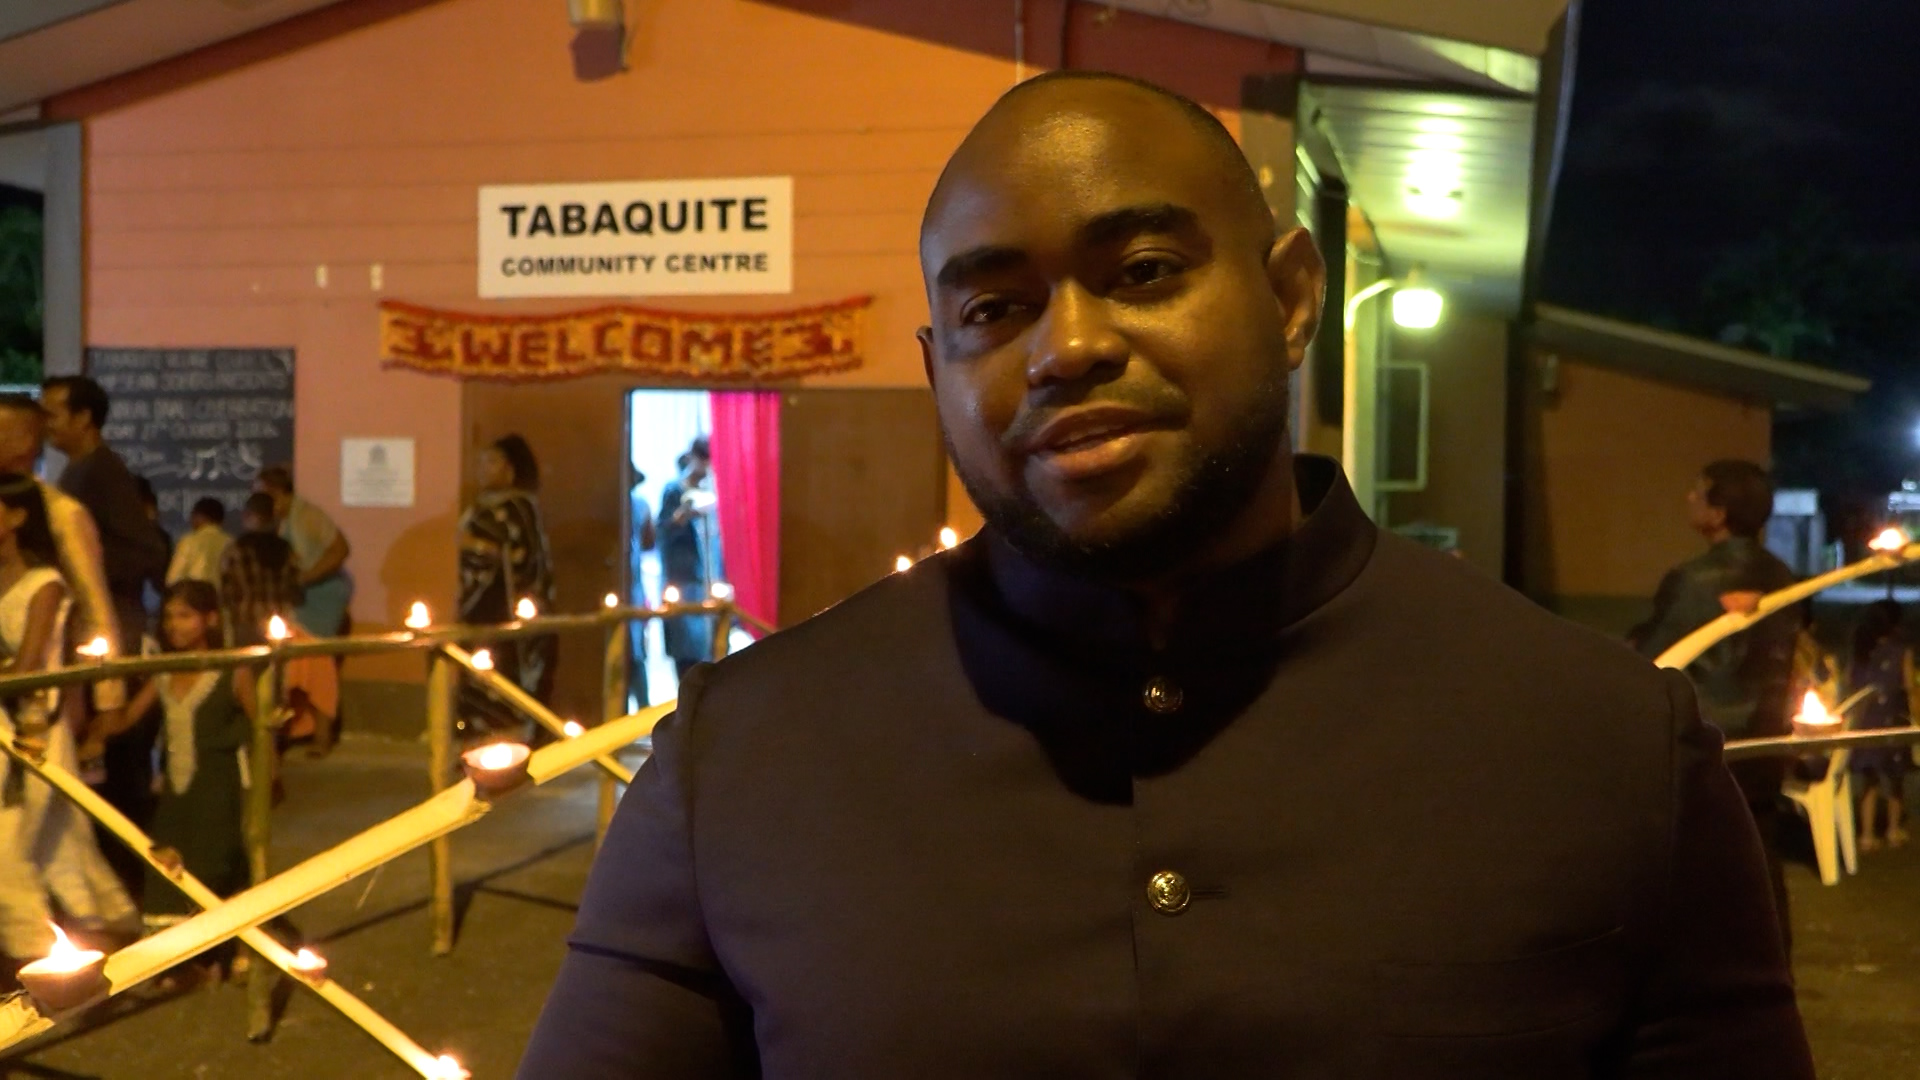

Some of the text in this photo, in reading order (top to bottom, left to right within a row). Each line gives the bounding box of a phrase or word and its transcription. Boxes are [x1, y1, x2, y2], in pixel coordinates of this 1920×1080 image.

[502, 197, 768, 237] TABAQUITE
[502, 254, 768, 276] COMMUNITY CENTRE
[462, 319, 773, 368] WELCOME
